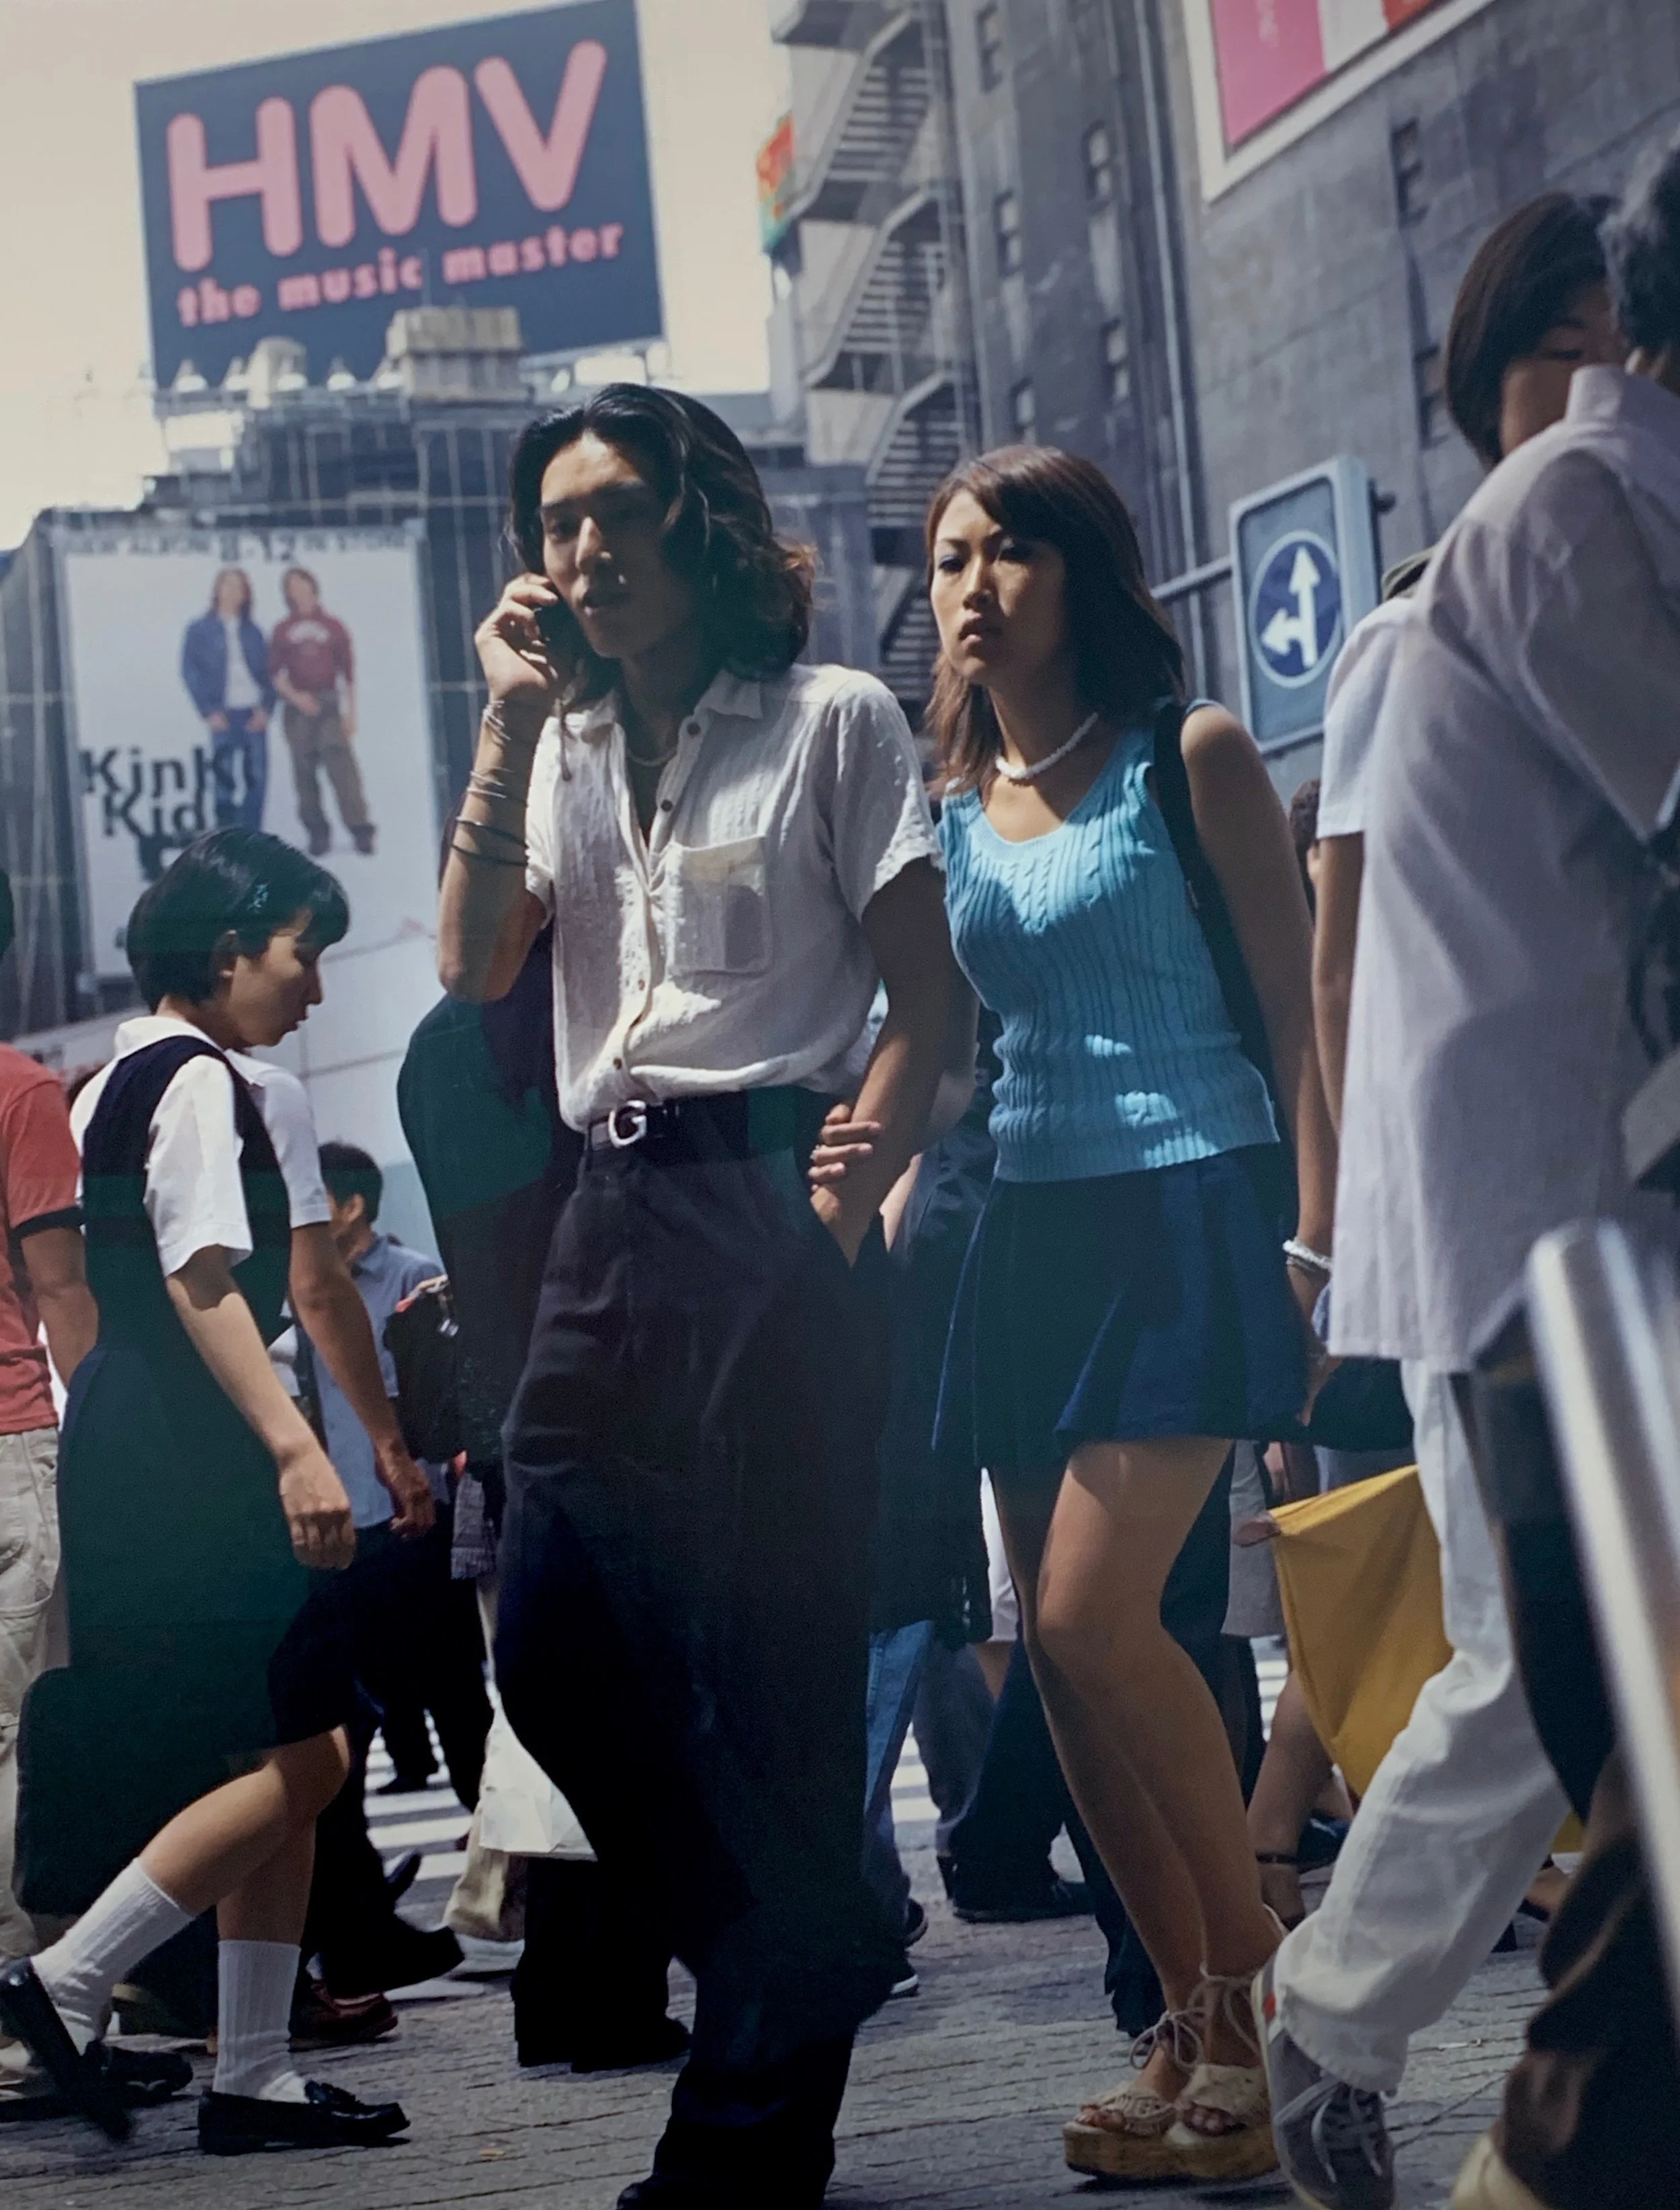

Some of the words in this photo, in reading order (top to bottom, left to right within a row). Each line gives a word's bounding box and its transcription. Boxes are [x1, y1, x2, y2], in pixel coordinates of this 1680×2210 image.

[167, 39, 607, 272] HMV
[177, 276, 261, 327] the
[277, 246, 423, 312] music
[441, 222, 623, 284] master
